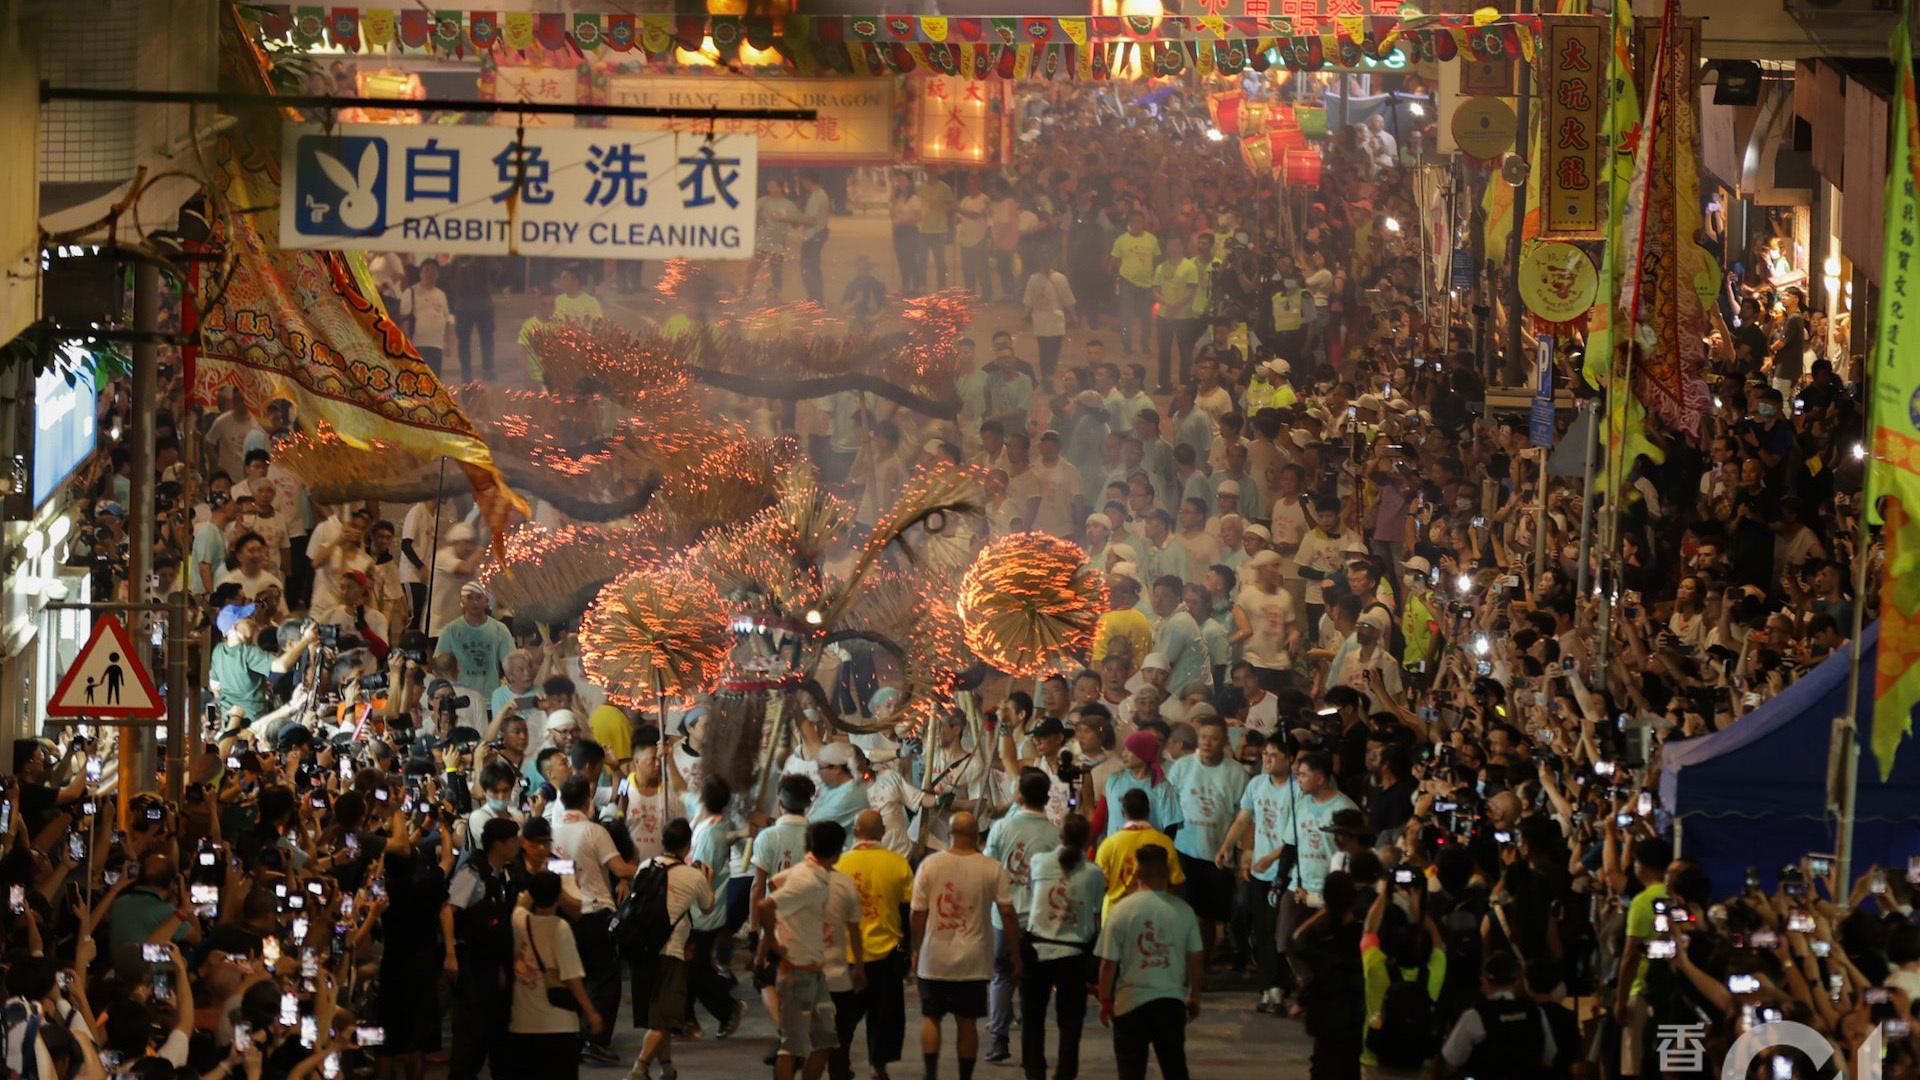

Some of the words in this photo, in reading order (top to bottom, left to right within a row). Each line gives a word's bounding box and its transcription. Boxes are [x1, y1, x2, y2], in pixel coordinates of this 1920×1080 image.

[617, 92, 648, 105] TAI
[668, 92, 720, 106] HANG
[740, 92, 781, 106] FIRE
[803, 93, 881, 107] DRAGON
[1558, 38, 1592, 190] 大坑火龍
[404, 137, 741, 209] 白兔洗衣
[403, 217, 511, 242] RABBIT
[521, 220, 580, 243] DRY
[589, 222, 741, 248] CLEANING
[1538, 341, 1550, 391] P
